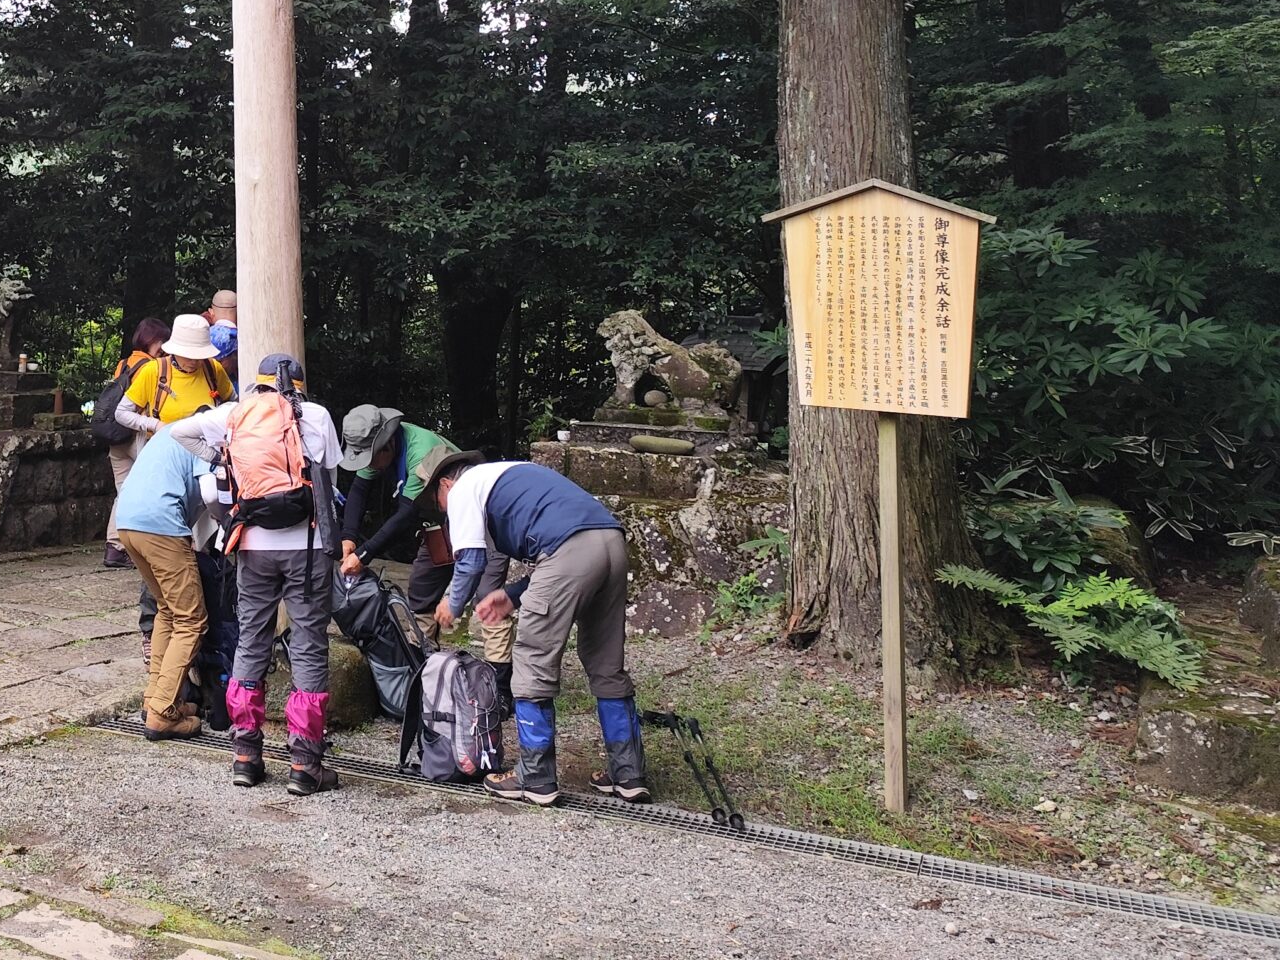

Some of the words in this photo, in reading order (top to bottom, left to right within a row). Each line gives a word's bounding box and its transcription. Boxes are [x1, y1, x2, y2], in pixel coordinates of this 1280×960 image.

[933, 217, 952, 329] 御尊像完成余話
[803, 332, 813, 398] 平成二十九年九月
